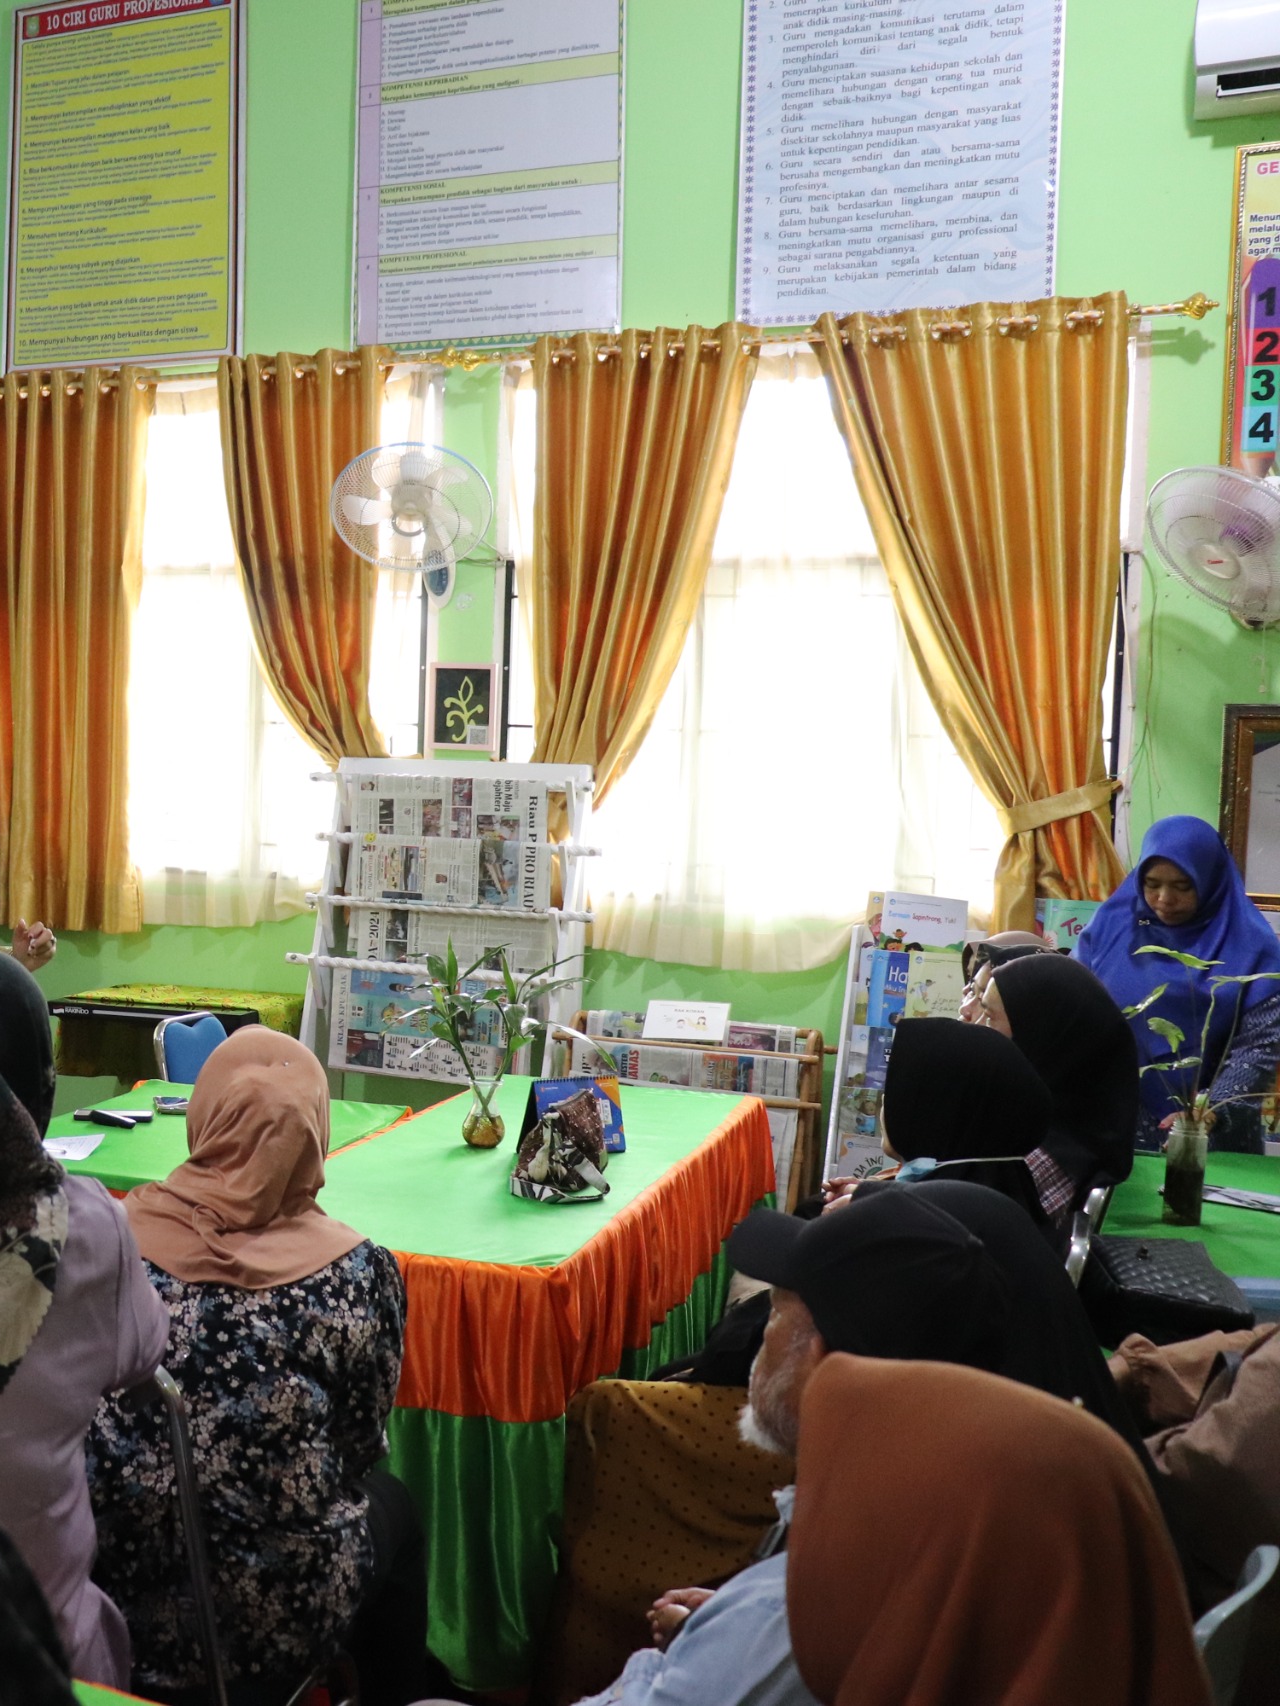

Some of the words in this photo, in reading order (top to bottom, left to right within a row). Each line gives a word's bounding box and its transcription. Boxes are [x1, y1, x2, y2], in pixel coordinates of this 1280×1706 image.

[47, 15, 60, 30] 10
[63, 11, 86, 27] CIRI
[89, 5, 120, 23] GURU
[779, 195, 802, 204] Guru
[808, 190, 866, 202] menciptakan
[871, 188, 888, 196] dan
[894, 183, 948, 194] memelihara
[955, 180, 978, 189] antar
[984, 177, 1019, 186] sesama
[779, 208, 802, 218] guru,
[810, 204, 829, 213] baik
[838, 200, 893, 211] berdasarkan
[901, 195, 954, 206] lingkungan
[962, 191, 1001, 201] maupun
[1009, 188, 1019, 196] di
[778, 230, 802, 239] Guru
[808, 225, 873, 237] bersama-sama
[880, 220, 938, 231] memelihara,
[946, 214, 993, 226] membina,
[1000, 212, 1018, 221] dan
[779, 219, 806, 227] dalam
[808, 215, 853, 225] hubungan
[856, 210, 914, 221] keseluruhan.
[778, 239, 842, 251] meningkatkan
[848, 237, 872, 245] mutu
[877, 231, 925, 244] organisasi
[931, 231, 953, 241] guru
[959, 224, 1018, 239] professional
[1249, 236, 1271, 246] yang
[777, 265, 801, 274] Guru
[813, 260, 878, 271] melaksanakan
[891, 256, 920, 267] segala
[933, 252, 980, 263] ketentuan
[993, 249, 1017, 259] yang
[778, 252, 811, 263] sebagai
[814, 252, 843, 260] sarana
[1248, 247, 1270, 256] agar
[777, 275, 827, 286] merupakan
[834, 272, 879, 283] kebijakan
[886, 267, 939, 280] pemerintah
[946, 264, 976, 274] dalam
[984, 262, 1017, 271] bidang
[777, 287, 829, 299] pendidikan.
[1256, 286, 1277, 317] 1
[1254, 331, 1280, 363] 2
[1251, 369, 1276, 401] 3
[1248, 412, 1274, 443] 4
[494, 779, 502, 812] ejahtera
[529, 796, 538, 829] Riau
[368, 911, 380, 939] 2024
[340, 974, 348, 997] SIAK
[338, 998, 346, 1015] KPU
[337, 1016, 345, 1046] IKLAN
